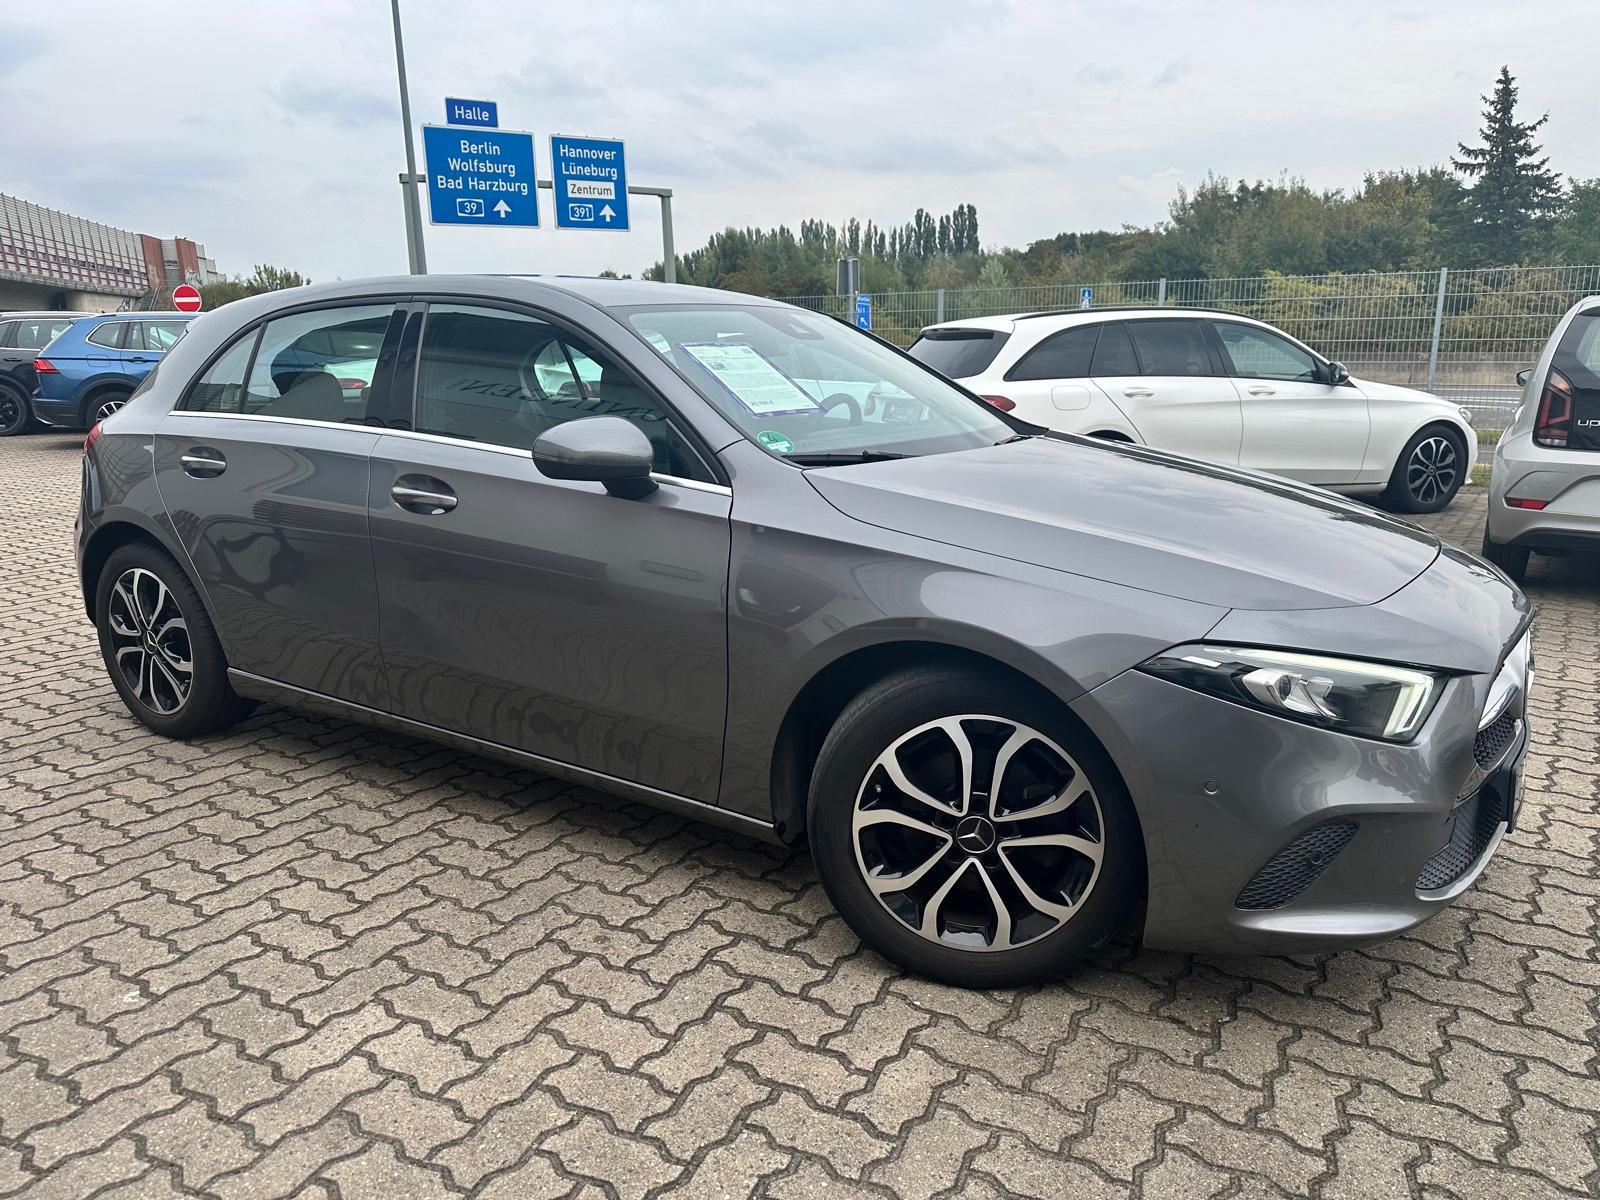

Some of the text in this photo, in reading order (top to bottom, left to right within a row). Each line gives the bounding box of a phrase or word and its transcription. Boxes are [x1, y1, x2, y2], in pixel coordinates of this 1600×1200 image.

[455, 105, 489, 121] Halle
[460, 140, 500, 155] Berlin
[560, 144, 616, 160] Hannover
[448, 157, 516, 177] Wolfsburg
[562, 162, 617, 180] Lüneburg
[437, 176, 528, 195] Bad Harzburg
[570, 183, 612, 196] Zentrum
[464, 202, 477, 213] 39
[573, 206, 590, 218] 391
